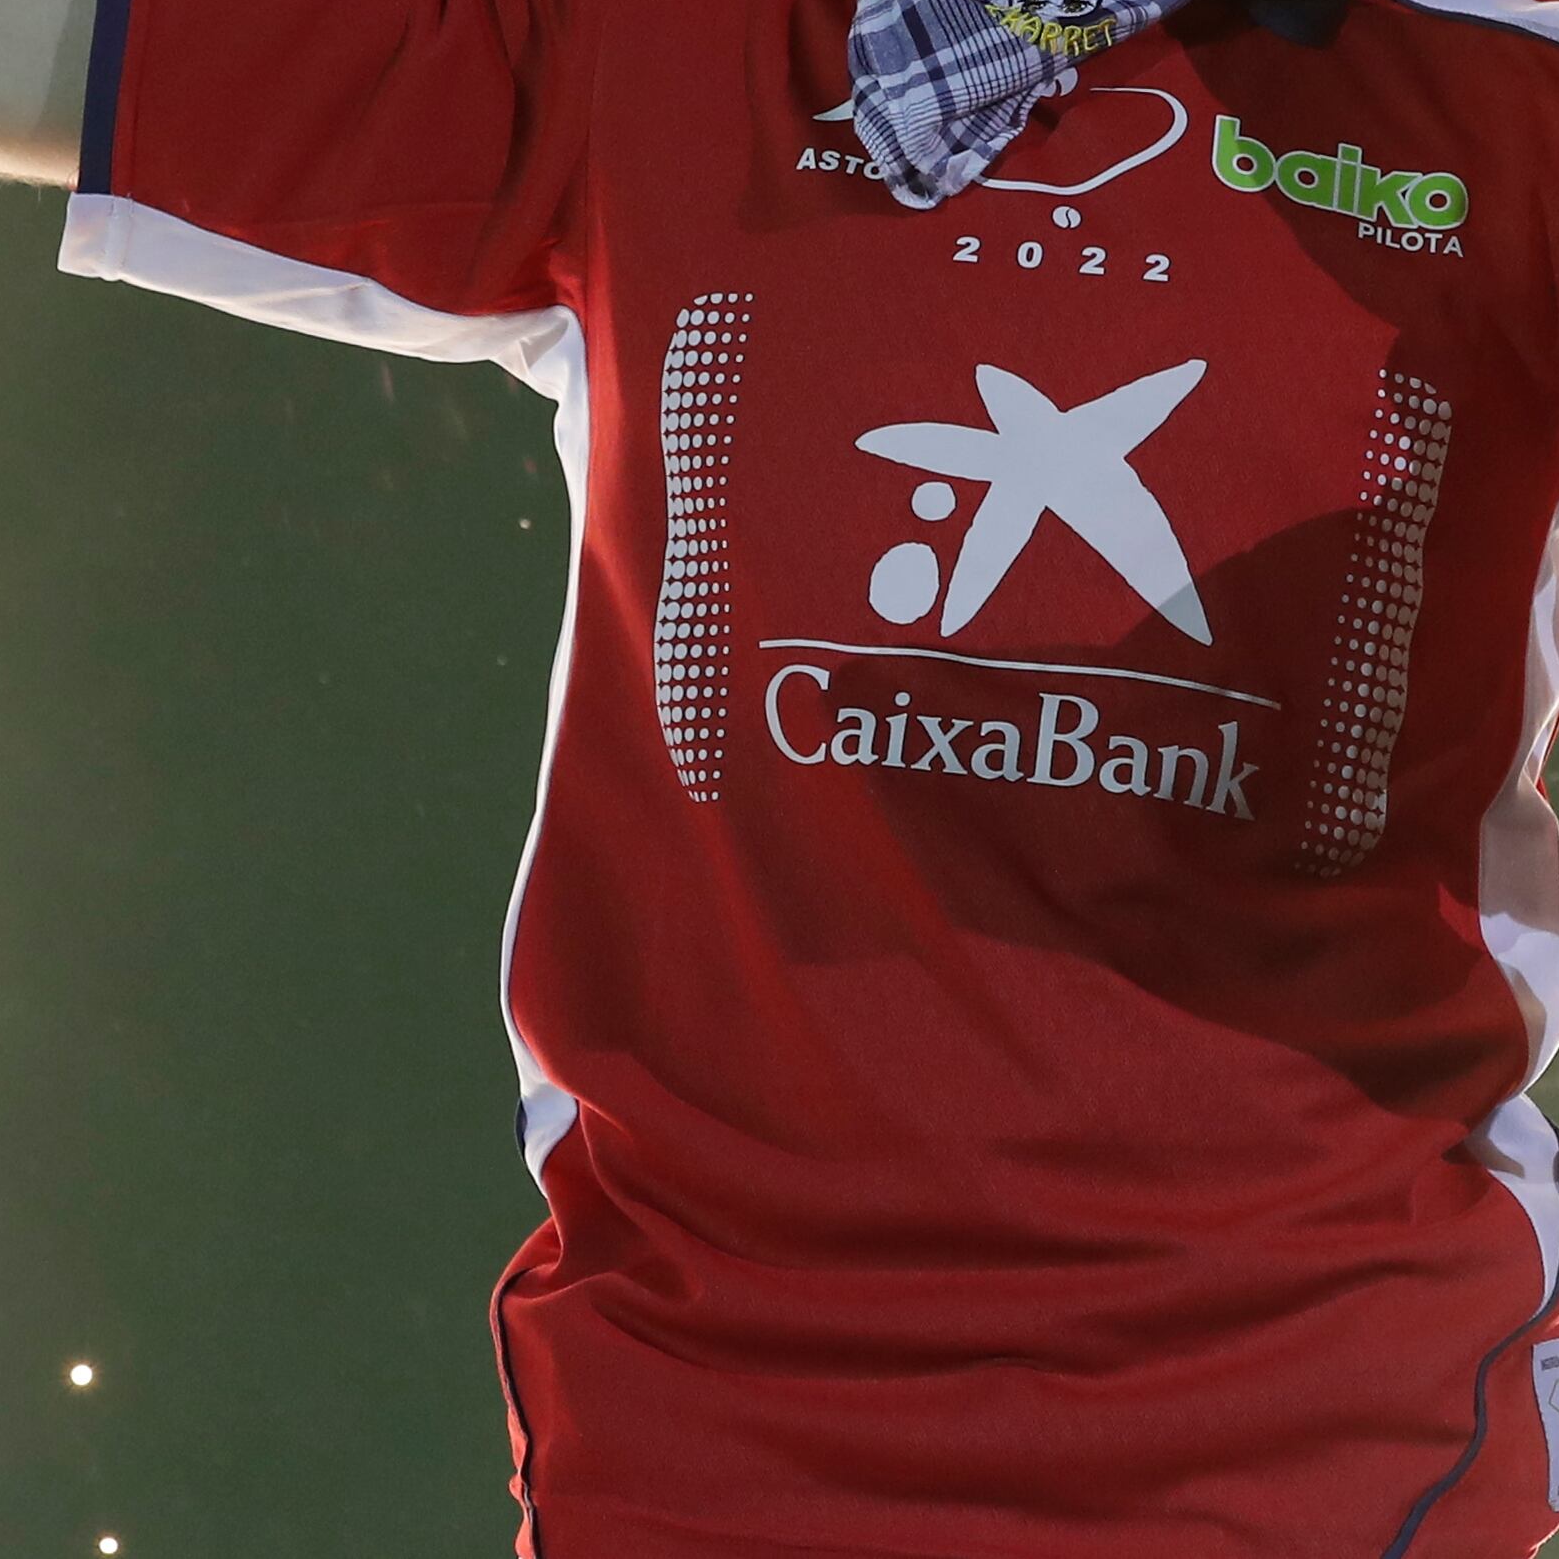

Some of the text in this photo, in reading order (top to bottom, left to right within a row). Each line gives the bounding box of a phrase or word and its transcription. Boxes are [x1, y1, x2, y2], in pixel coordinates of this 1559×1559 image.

[1212, 114, 1469, 231] baiko
[1358, 222, 1464, 258] PILOTA
[764, 663, 1259, 822] CaixaBank
